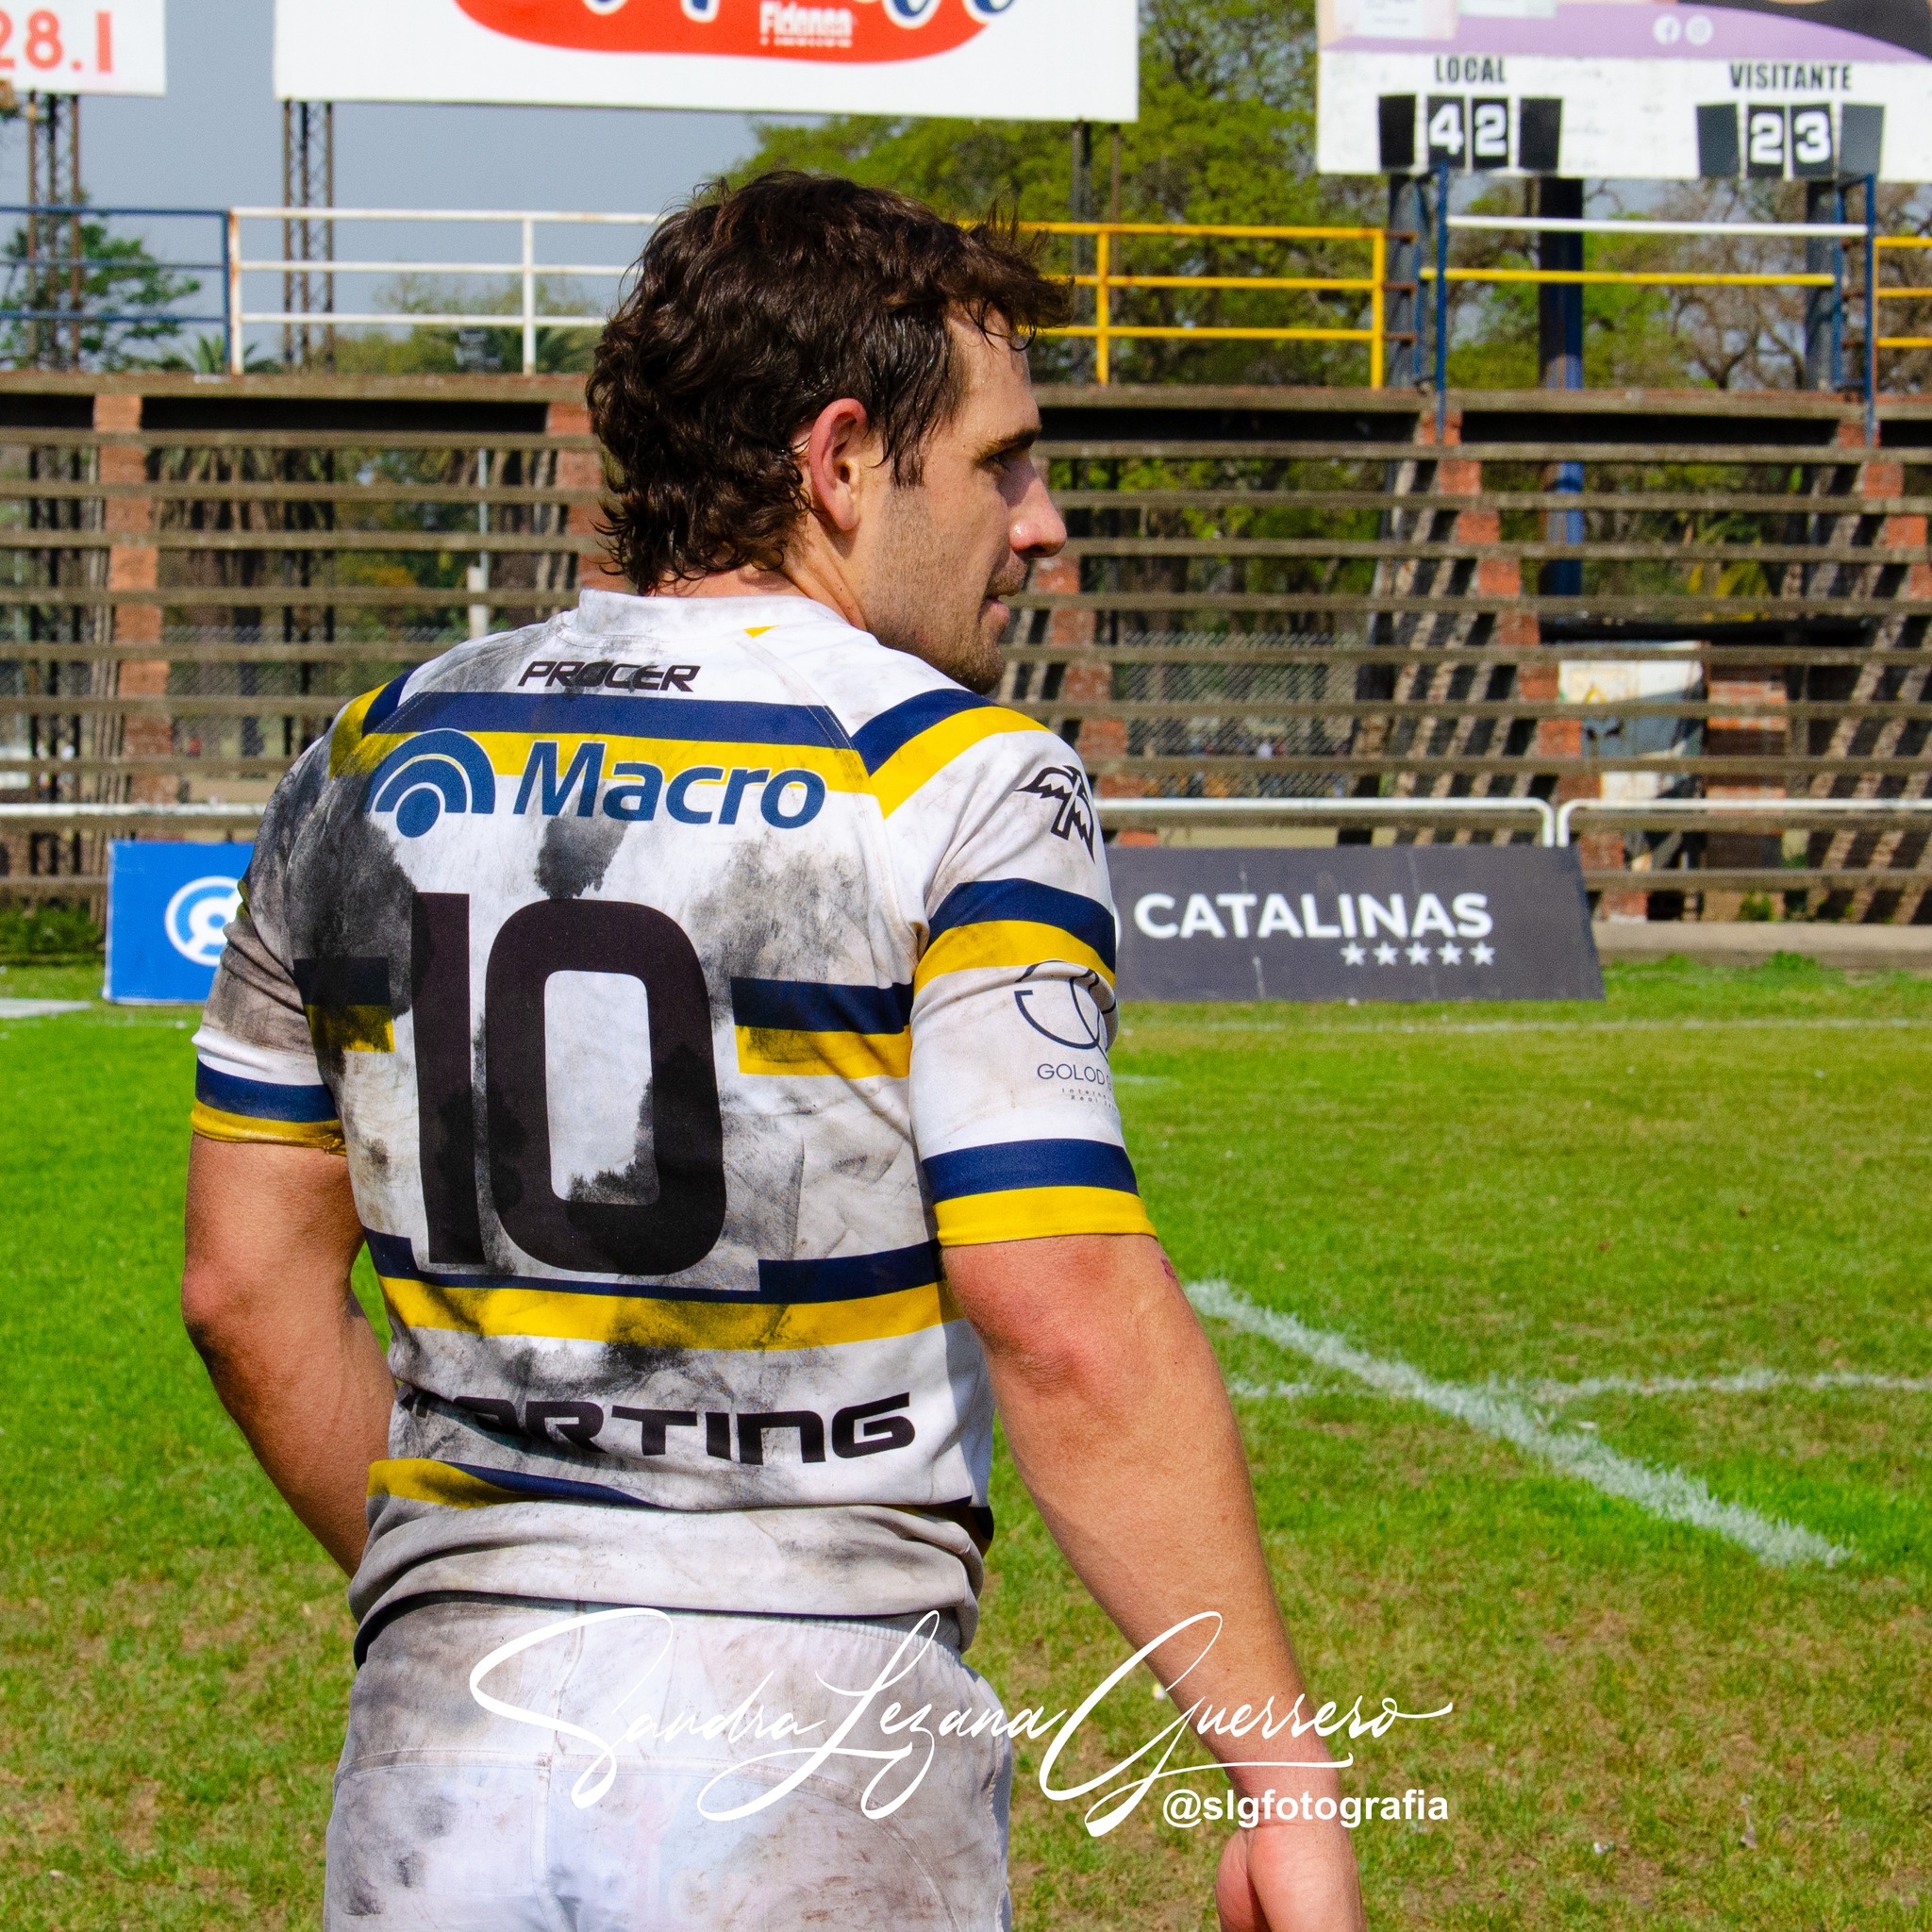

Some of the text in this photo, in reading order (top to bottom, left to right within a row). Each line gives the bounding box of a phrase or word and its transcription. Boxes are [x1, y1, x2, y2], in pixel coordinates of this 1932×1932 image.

[1435, 56, 1507, 83] LOCAL
[1729, 63, 1852, 91] VISITANTE
[1428, 103, 1507, 158] 42
[1749, 110, 1832, 165] 23
[518, 660, 702, 692] PROCER
[512, 740, 826, 830] Macro
[1134, 893, 1493, 939] CATALINAS
[410, 891, 726, 1276] 10
[1037, 1063, 1112, 1091] GOLOD
